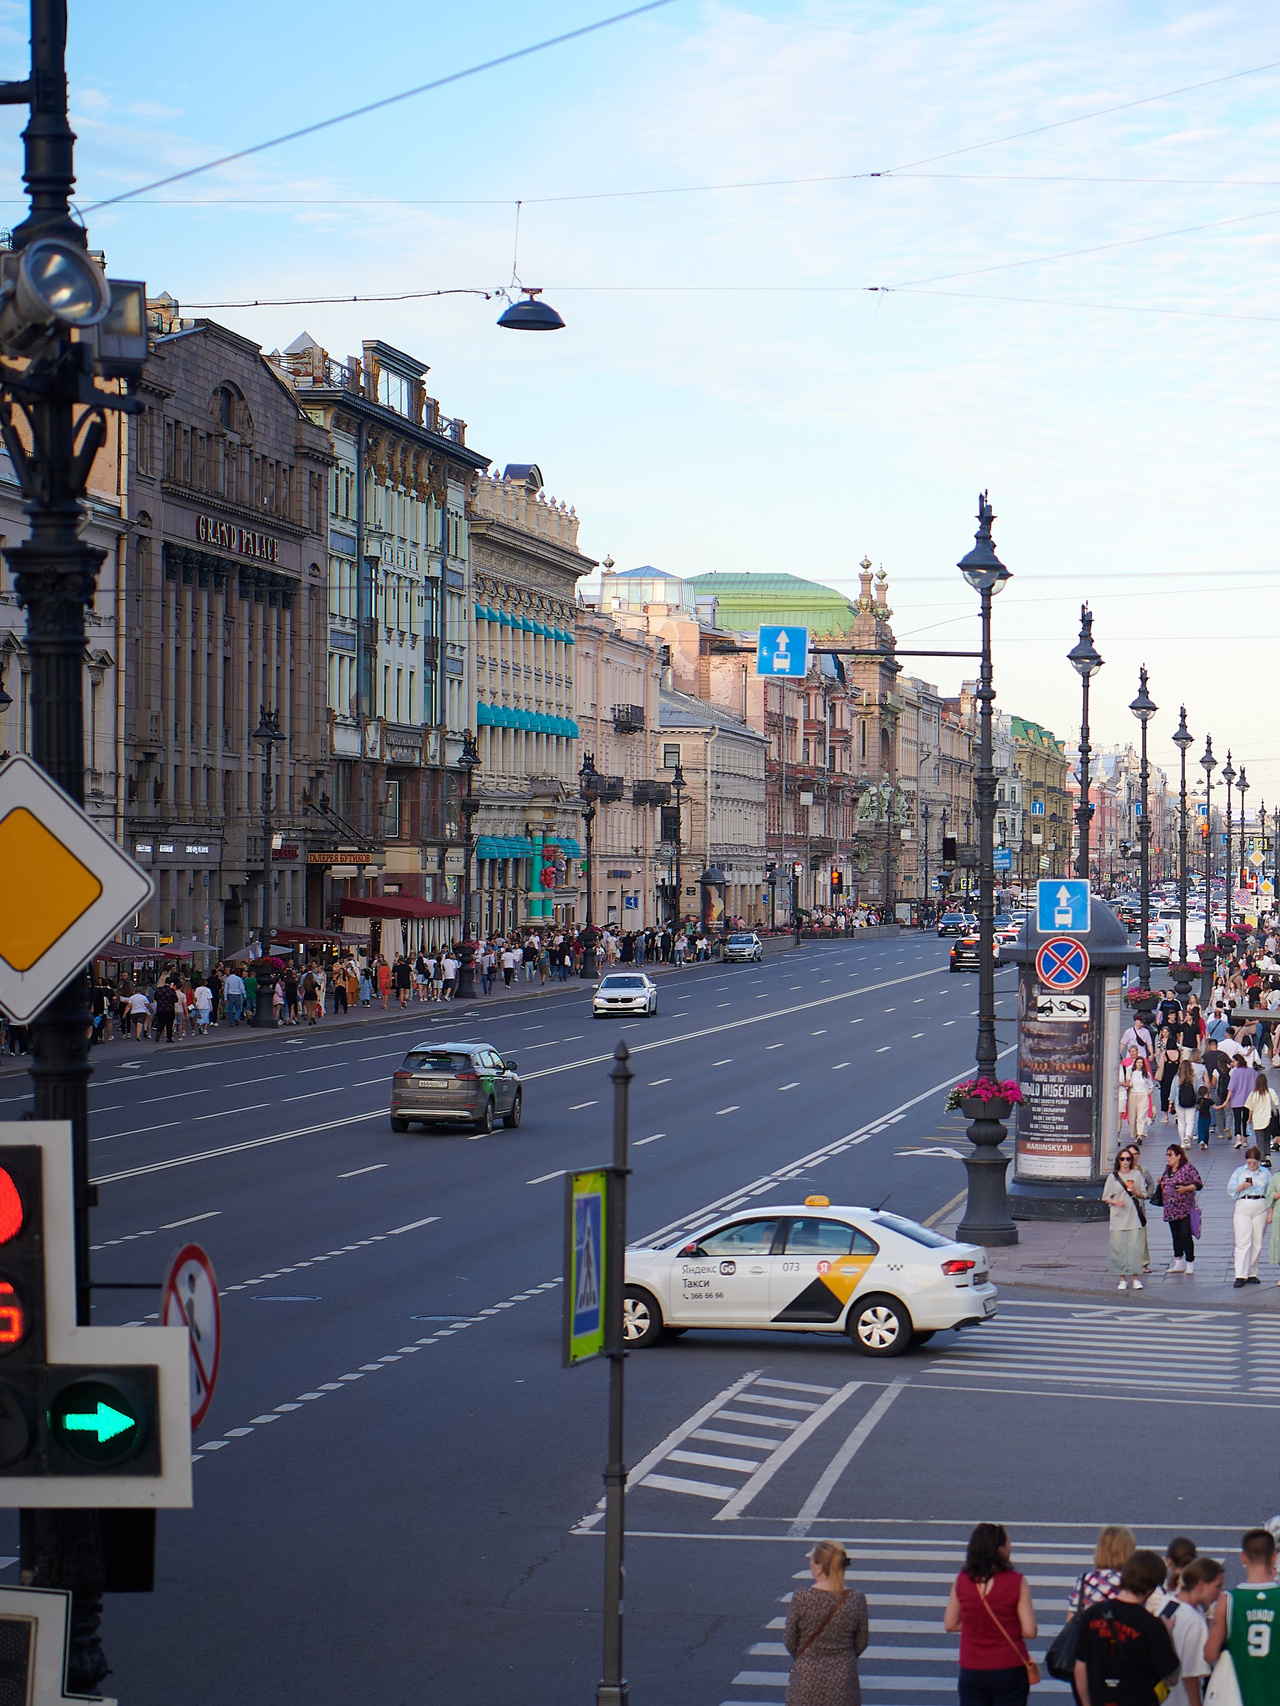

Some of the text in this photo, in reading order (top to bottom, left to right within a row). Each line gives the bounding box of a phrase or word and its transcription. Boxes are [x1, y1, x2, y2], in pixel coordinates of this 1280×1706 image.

[197, 515, 279, 562] GRAND PALACE
[309, 853, 371, 863] ГАЛЕРЕЯ БУТИКОВ
[1042, 1083, 1093, 1098] НИБЕЛУНГА
[1026, 1142, 1073, 1152] MARIINSKY.RU
[682, 1263, 735, 1274] Яндекс Go
[782, 1262, 800, 1272] 073
[682, 1278, 710, 1288] Такси
[690, 1292, 703, 1300] 366
[1246, 1609, 1275, 1622] RONDO
[1247, 1623, 1271, 1657] 9
